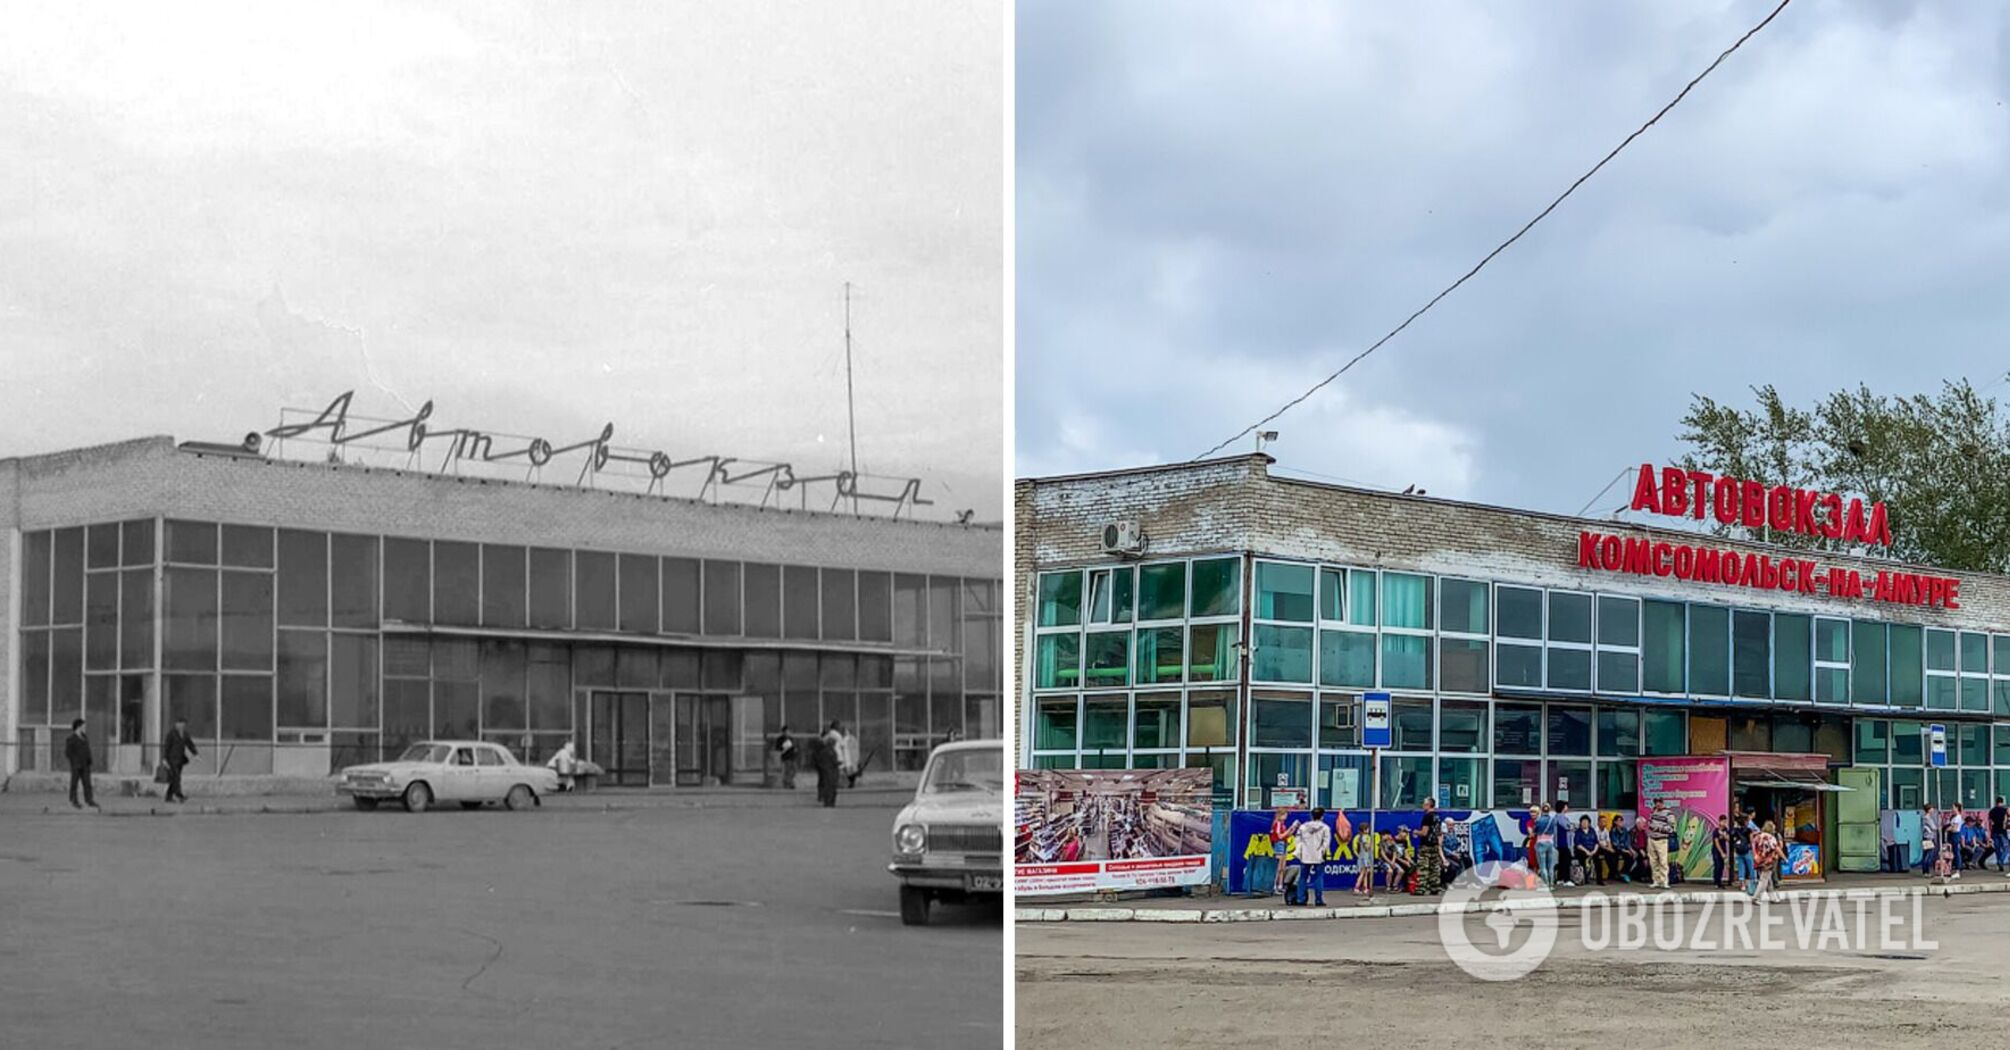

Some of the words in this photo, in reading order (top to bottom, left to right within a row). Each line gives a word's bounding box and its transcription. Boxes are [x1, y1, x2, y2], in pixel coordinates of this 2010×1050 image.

[1631, 463, 1892, 547] АВТОВОКЗАЛ
[1579, 531, 1961, 610] КОМСОМОЛЬСК-НА-АМУРЕ
[1324, 865, 1361, 875] ОДЕЖД
